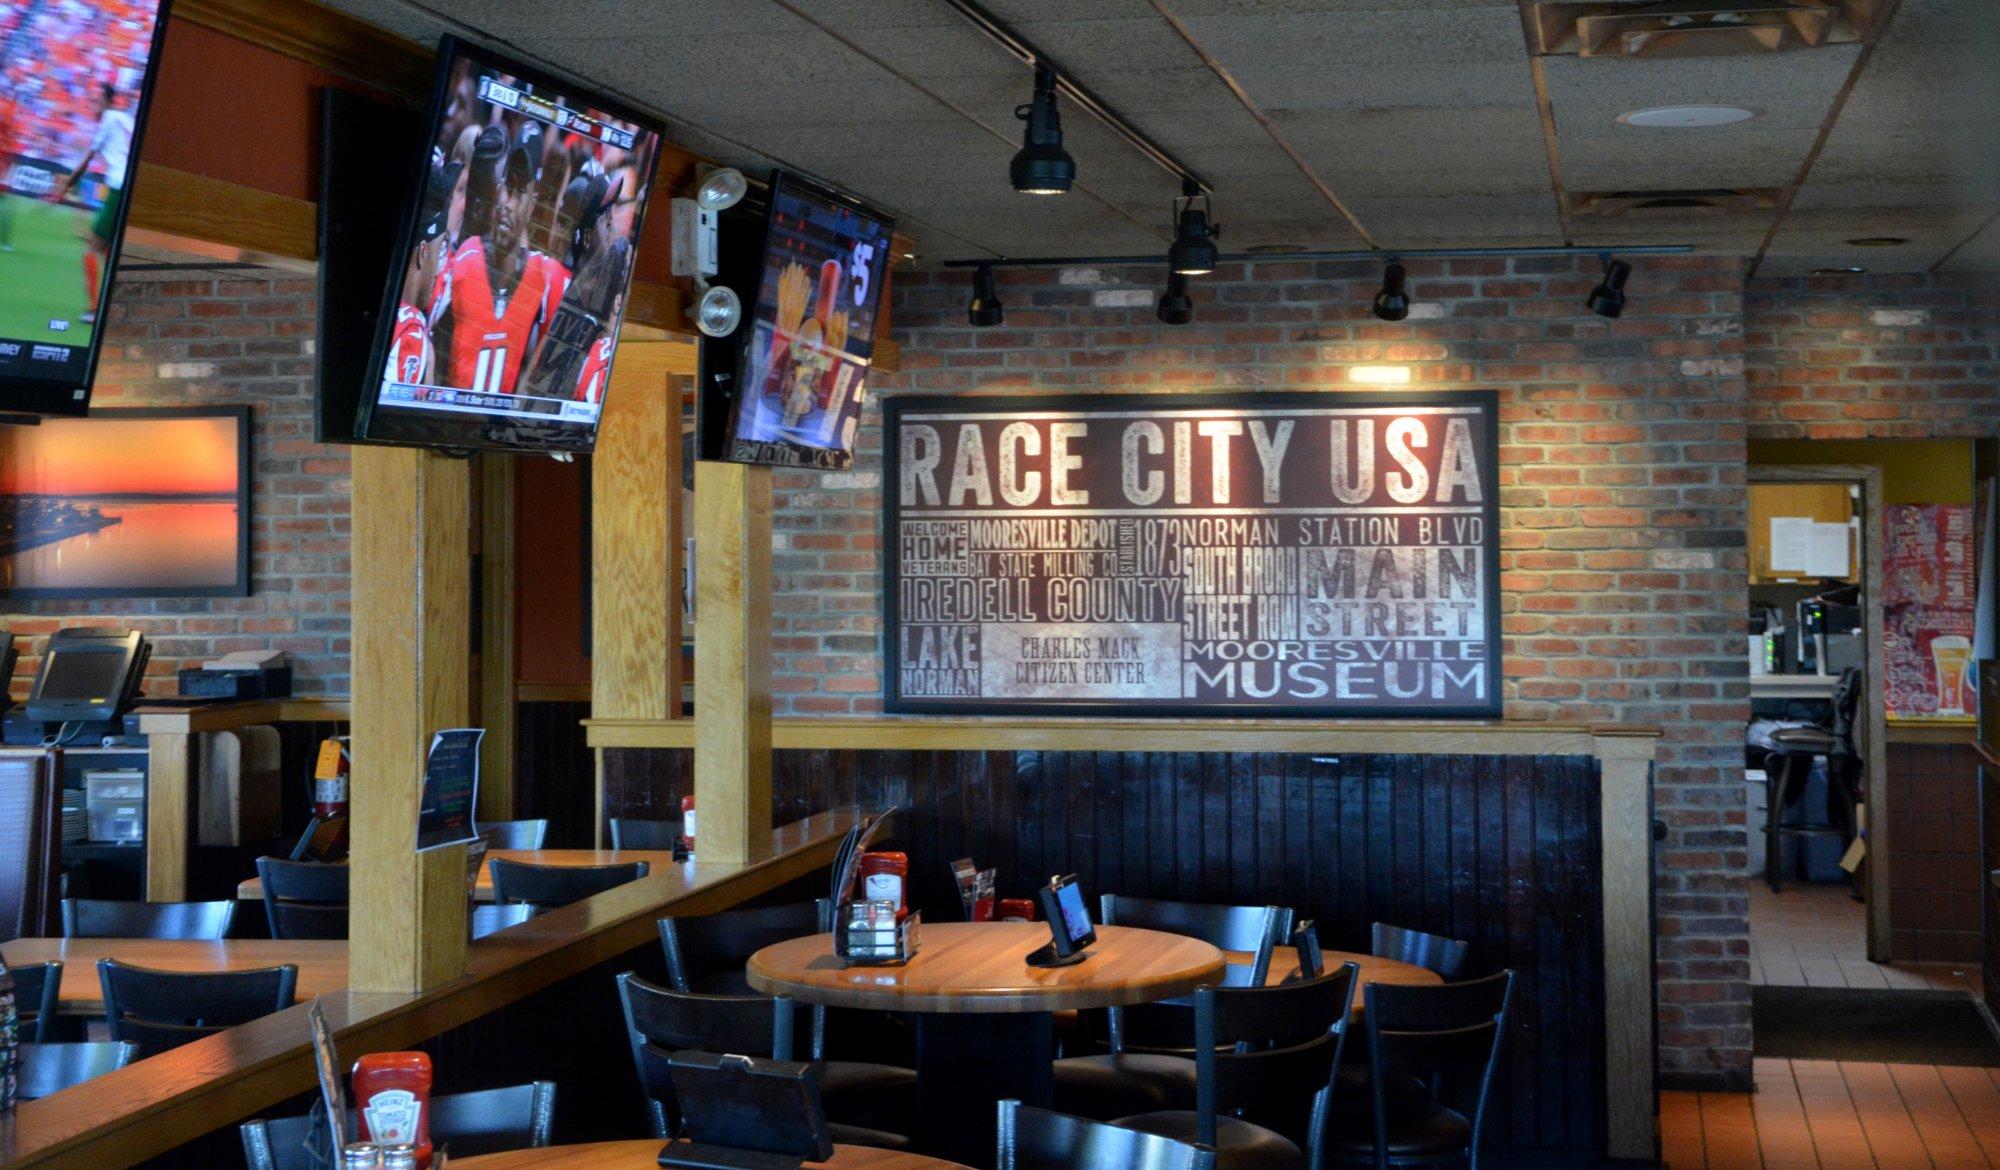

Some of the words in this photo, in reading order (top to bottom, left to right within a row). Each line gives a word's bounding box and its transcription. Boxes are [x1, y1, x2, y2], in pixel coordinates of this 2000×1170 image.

[900, 421, 1089, 507] RACE
[1122, 420, 1295, 506] CITY
[1331, 416, 1483, 504] USA
[902, 522, 967, 536] WELCOME
[969, 519, 1067, 549] MOORESVILLE
[1070, 518, 1118, 548] DEPOT
[1182, 517, 1280, 546] NORMAN
[1299, 517, 1400, 545] STATION
[1419, 516, 1484, 545] BLVD
[902, 537, 967, 560] HOME
[1119, 518, 1134, 577] ESTABLISHED
[1134, 518, 1180, 576] 1873
[902, 561, 967, 575] VETERANS
[969, 553, 991, 577] BAY
[998, 552, 1036, 577] STATE
[1043, 552, 1094, 577] MILLING
[1183, 546, 1237, 594] SOUTH
[1242, 546, 1297, 594] BROAD
[1306, 548, 1477, 599] MAIN
[900, 577, 1038, 623] IREDELL
[1046, 577, 1182, 622] COUNTY
[1183, 594, 1252, 640] STREET
[1257, 594, 1298, 640] ROW
[1306, 601, 1476, 637] STREET
[900, 626, 980, 669] LAKE
[1021, 636, 1092, 659] CHARLES
[1098, 636, 1141, 659] MACK
[1183, 641, 1485, 661] MOORESVILLE
[901, 669, 980, 695] NORMAN
[1015, 662, 1079, 684] CITIZEN
[1084, 662, 1147, 684] CENTER
[1183, 661, 1486, 699] MUSEUM
